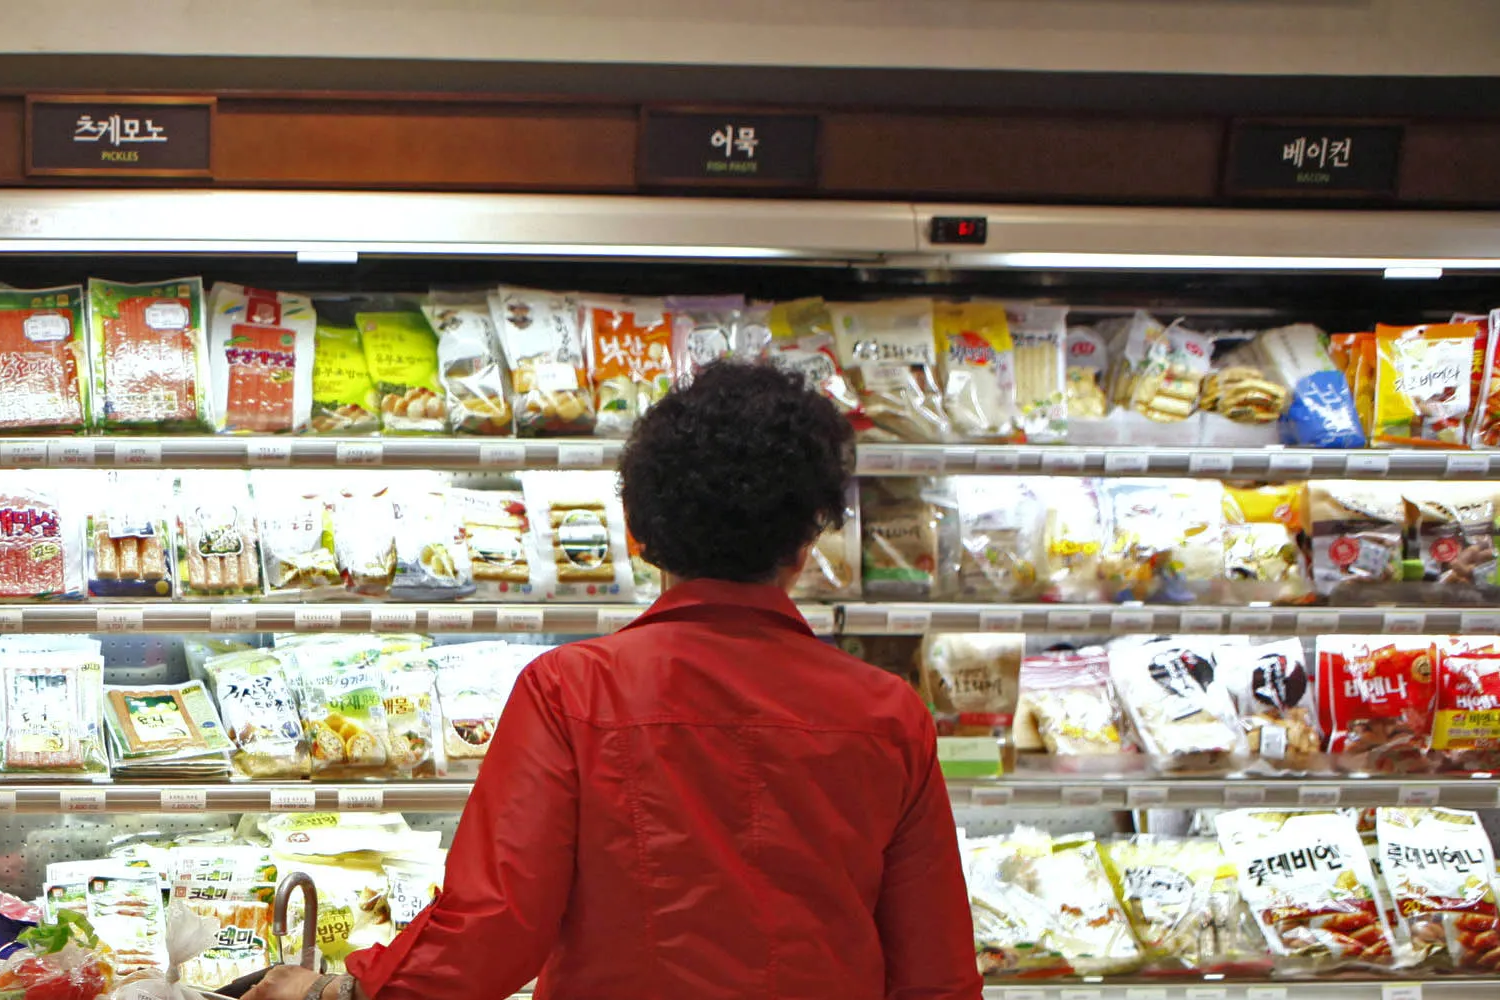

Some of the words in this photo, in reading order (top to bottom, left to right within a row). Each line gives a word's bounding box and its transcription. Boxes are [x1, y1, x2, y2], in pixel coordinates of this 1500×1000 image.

[73, 113, 168, 147] 츠케모노
[711, 124, 760, 158] 어묵
[101, 151, 139, 162] PICKLES
[1283, 137, 1353, 169] 베이컨
[213, 926, 255, 947] 래미
[316, 920, 351, 945] 밥왕
